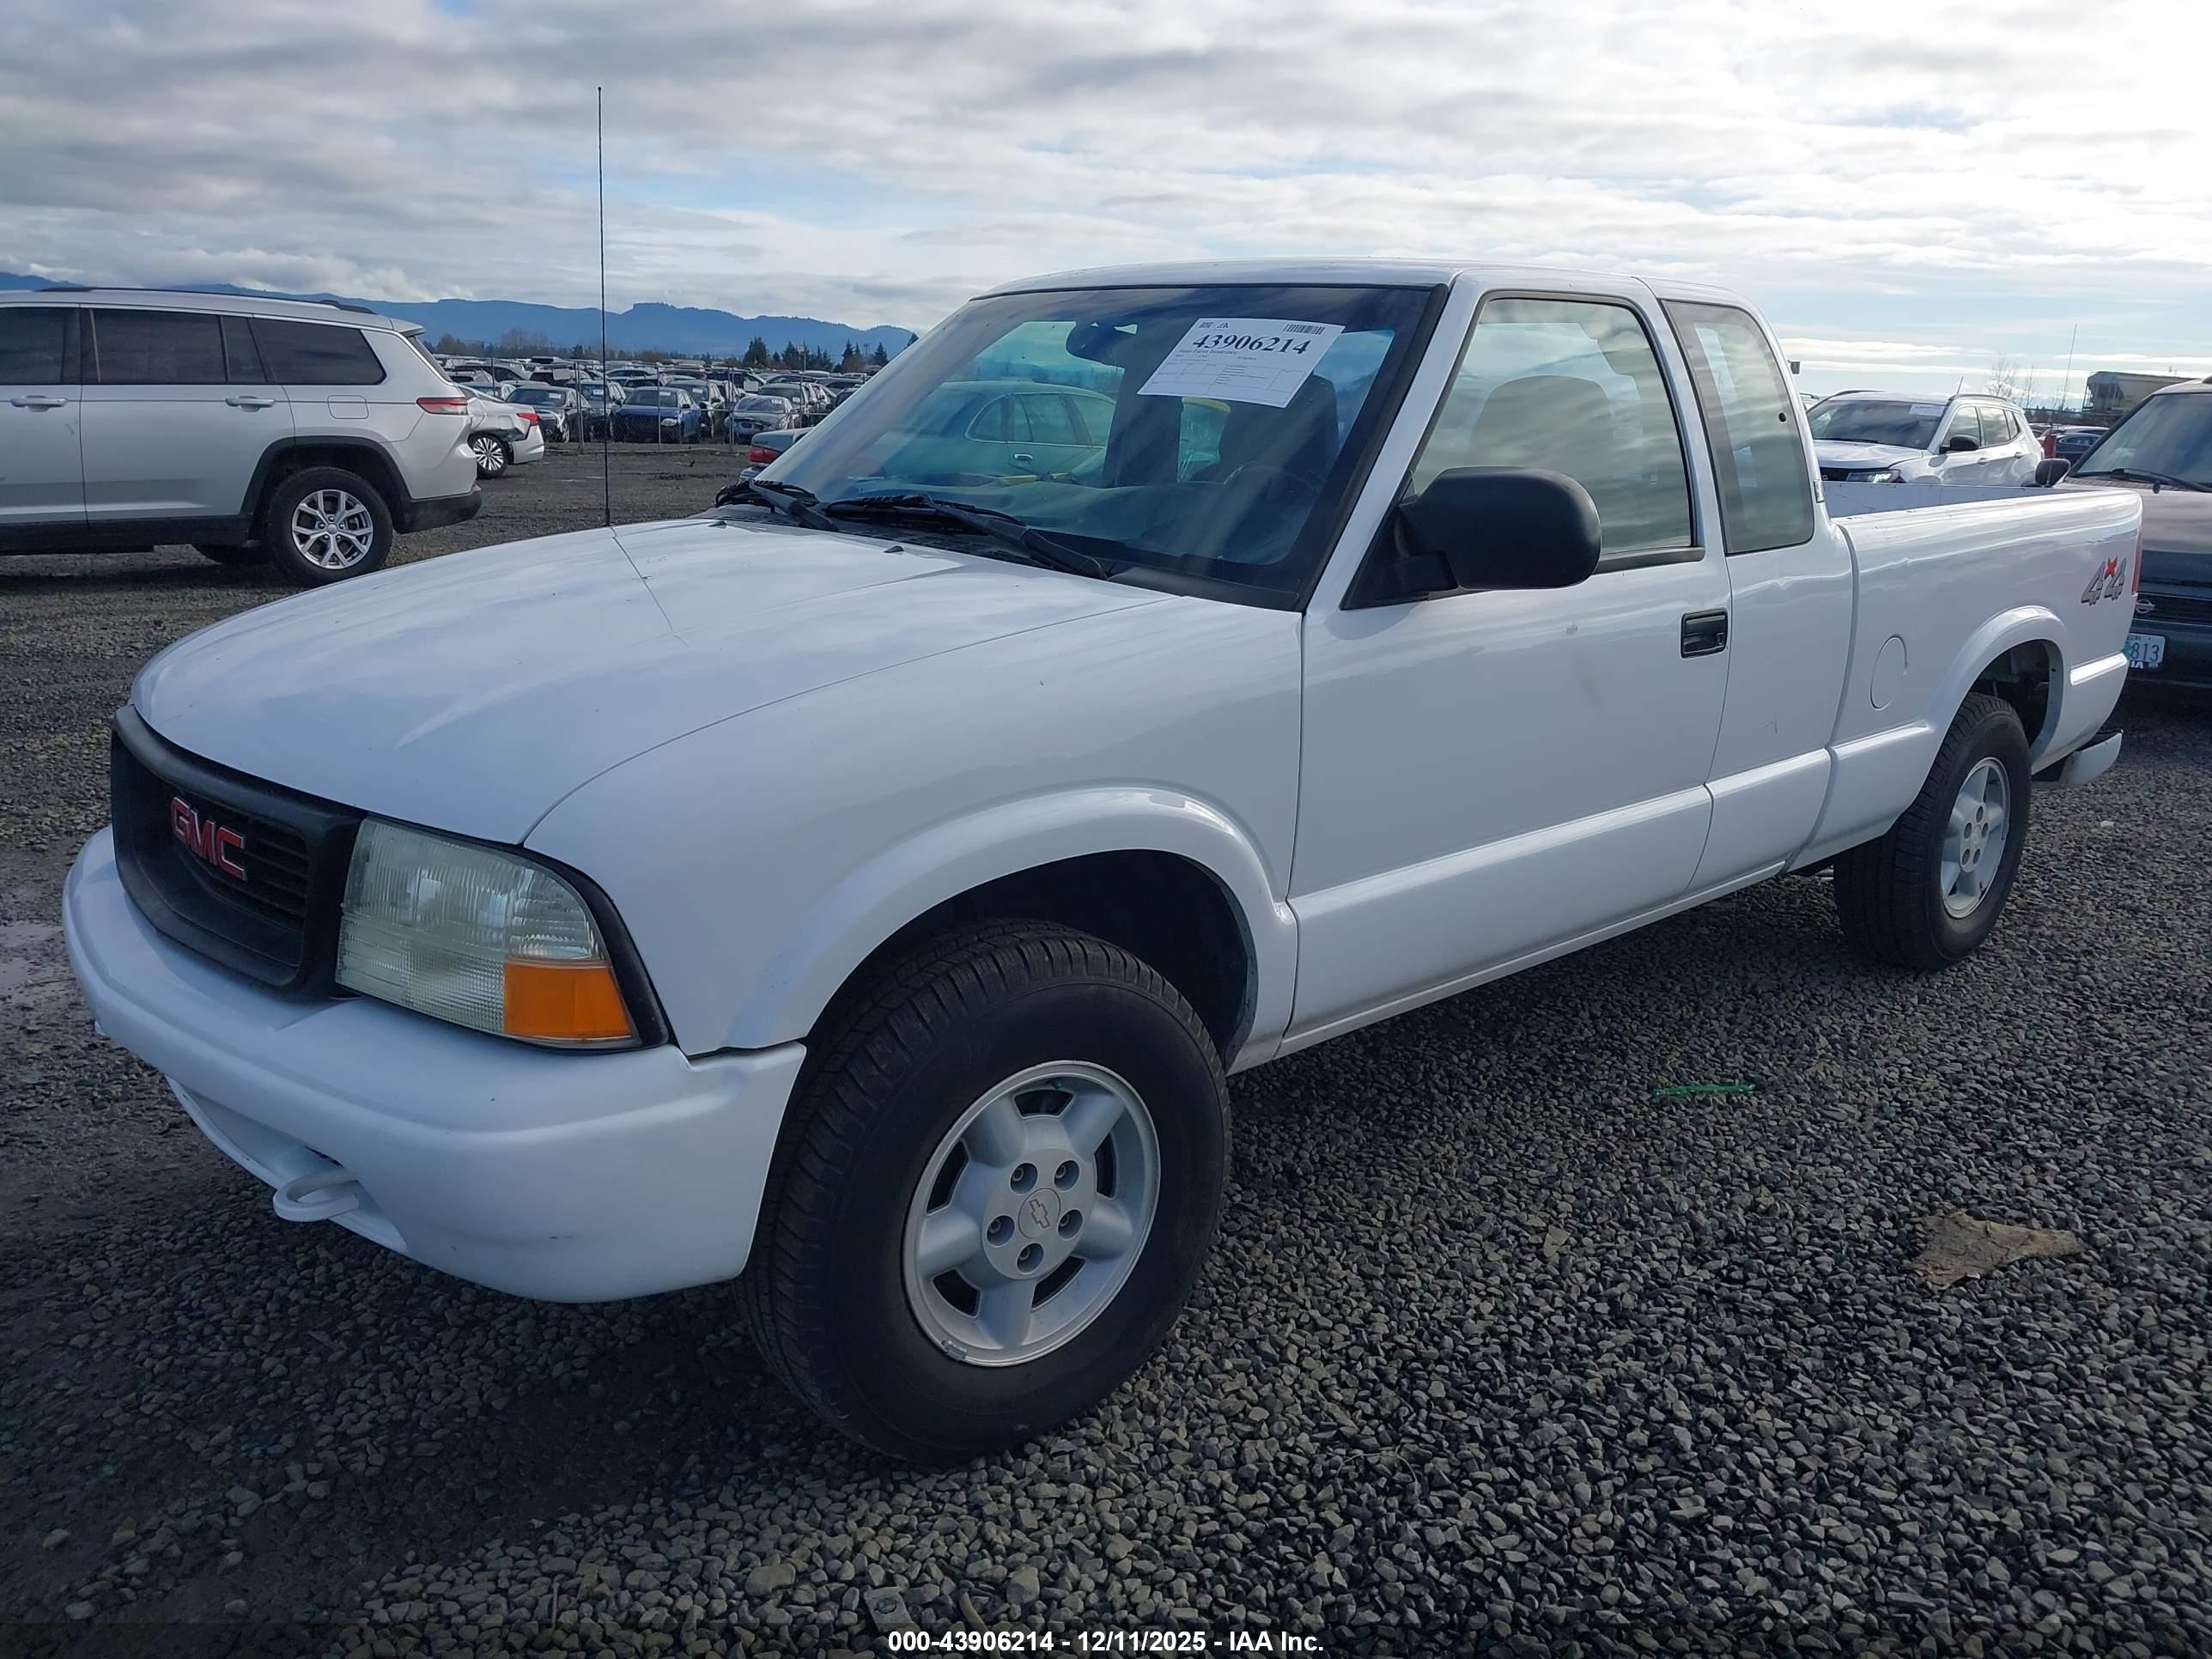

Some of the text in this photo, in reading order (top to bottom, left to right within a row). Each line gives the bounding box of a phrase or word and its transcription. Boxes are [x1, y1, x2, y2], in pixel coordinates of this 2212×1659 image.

[1192, 334, 1311, 355] 43906214
[2130, 642, 2160, 661] 813
[171, 796, 247, 881] GMC
